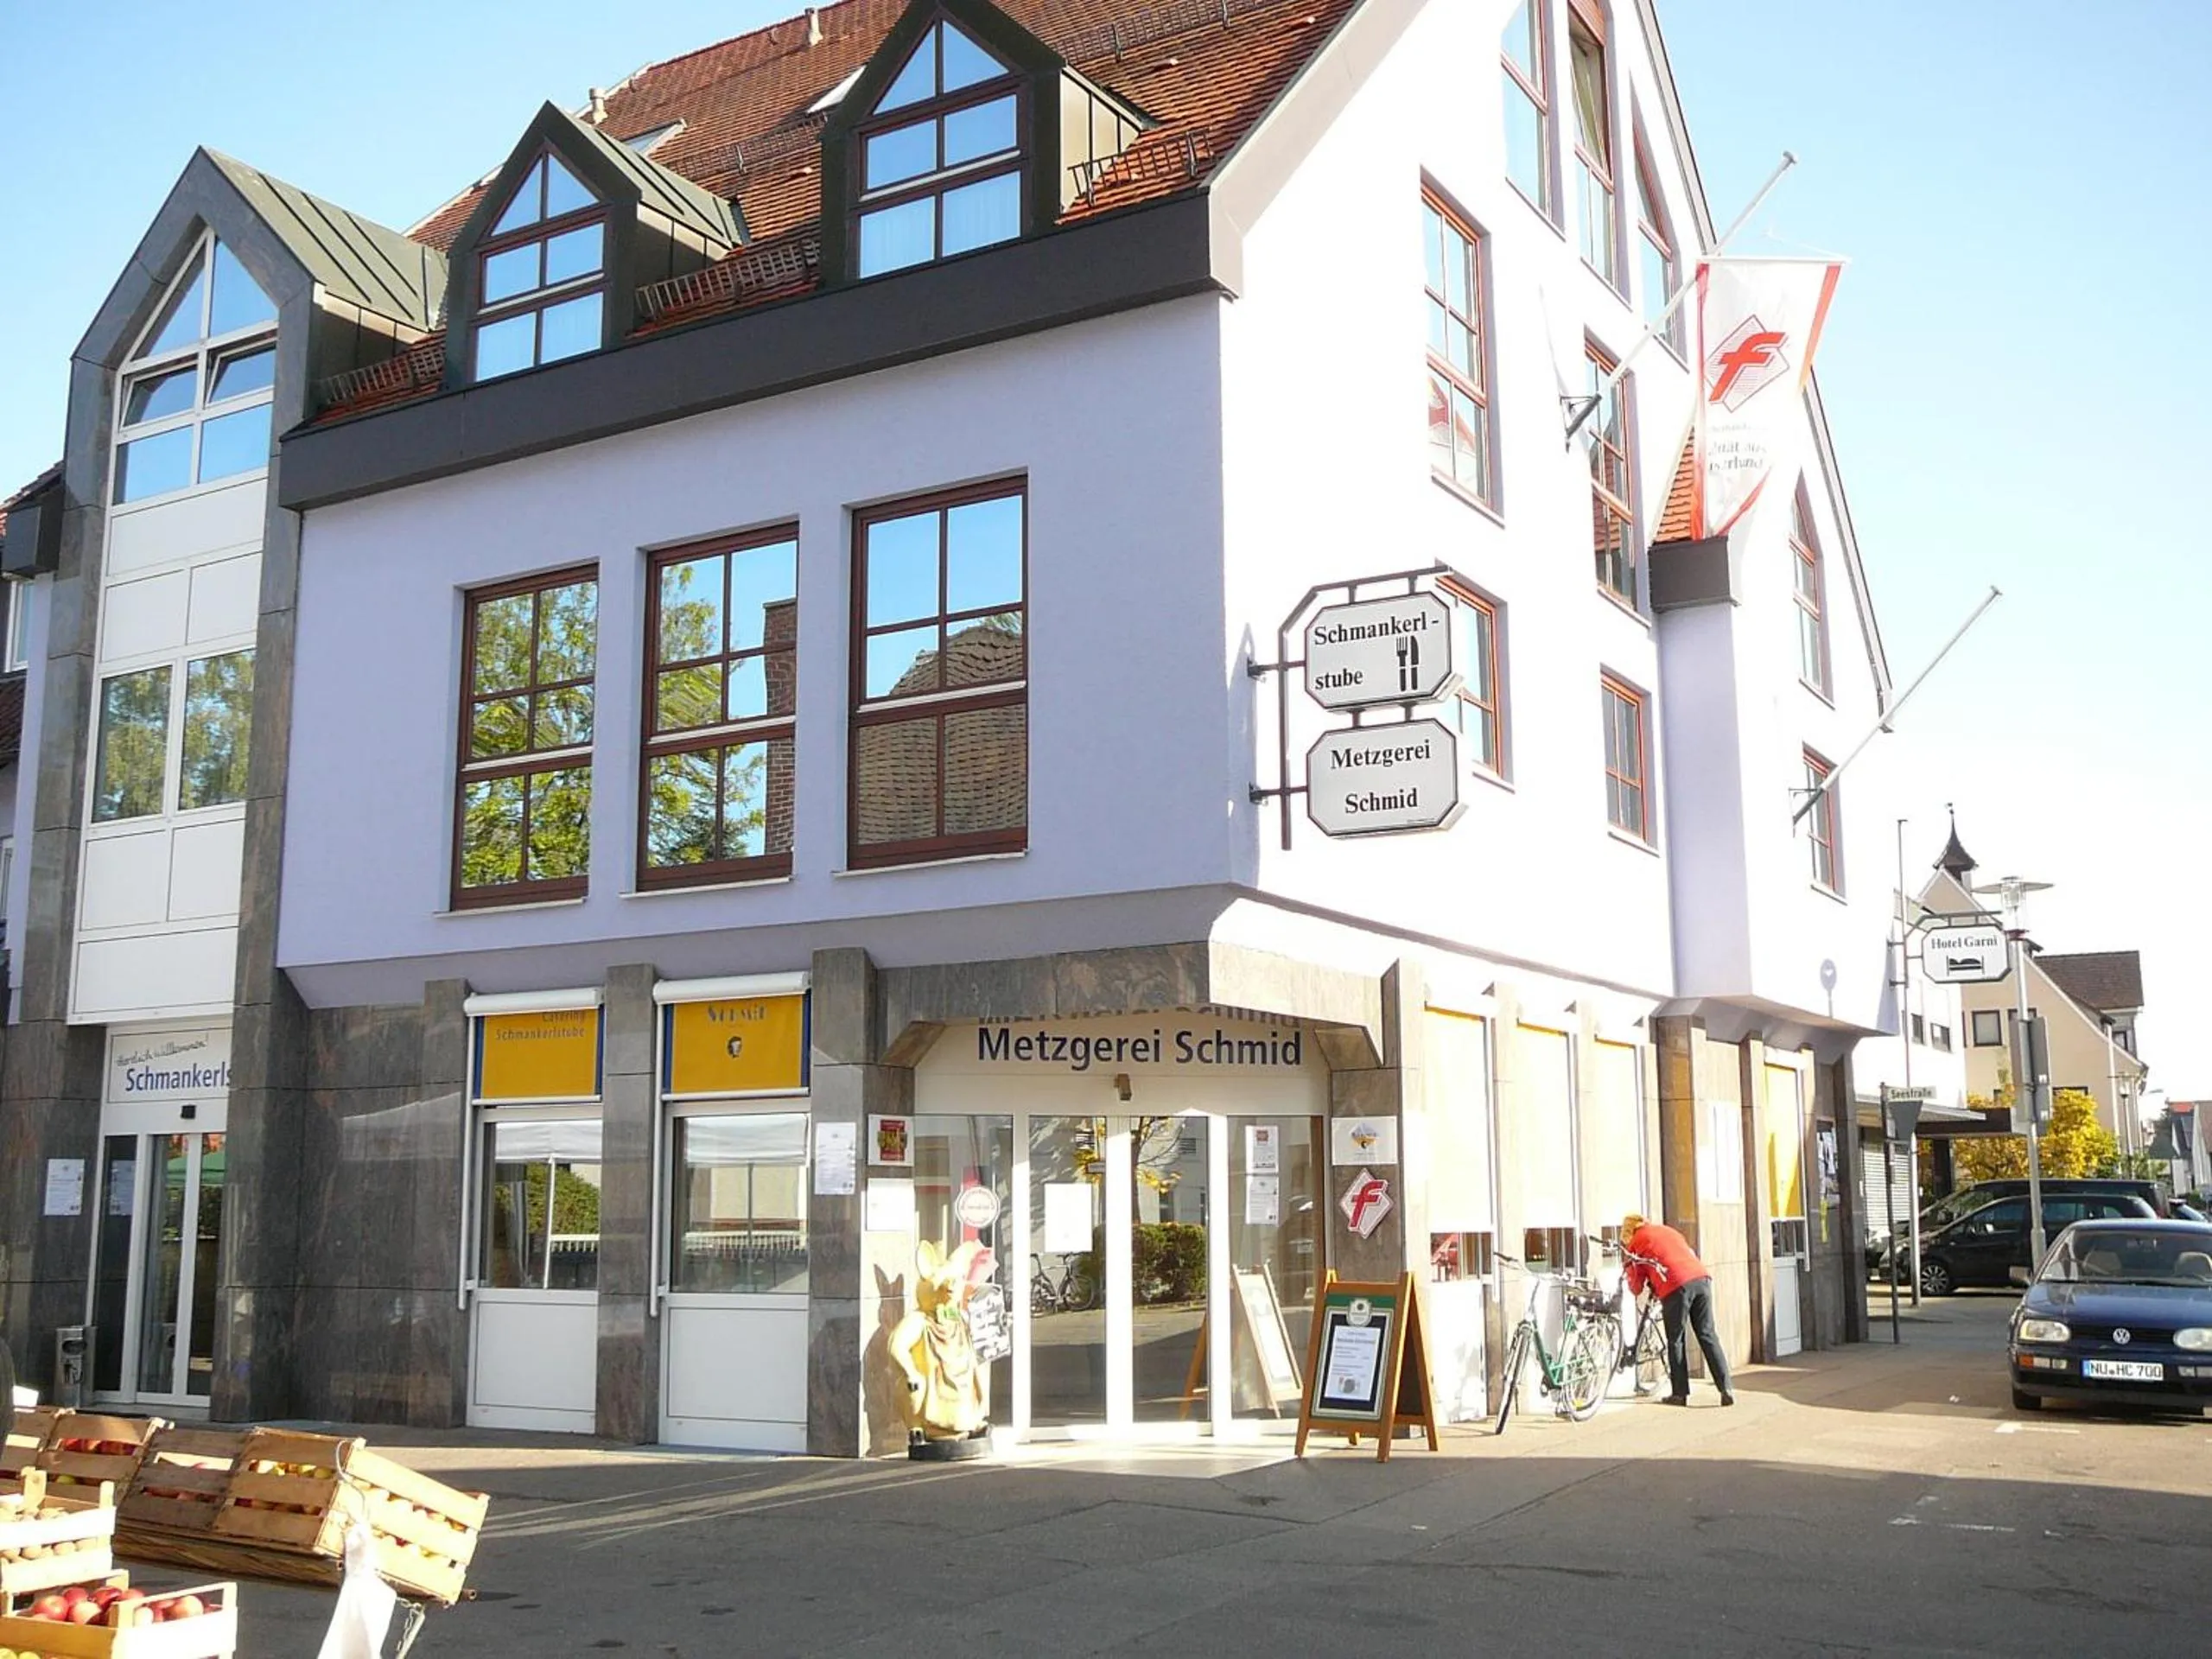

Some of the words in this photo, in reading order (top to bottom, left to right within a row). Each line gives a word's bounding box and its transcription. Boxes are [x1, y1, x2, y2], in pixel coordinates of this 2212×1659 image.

[1315, 668, 1363, 690] stube
[1331, 739, 1431, 769] Metzgerei
[1345, 787, 1418, 813] Schmid
[1931, 937, 1961, 949] Hotel
[1963, 935, 1998, 948] Garni
[977, 1027, 1160, 1071] Metzgerei
[1175, 1028, 1302, 1065] Schmid
